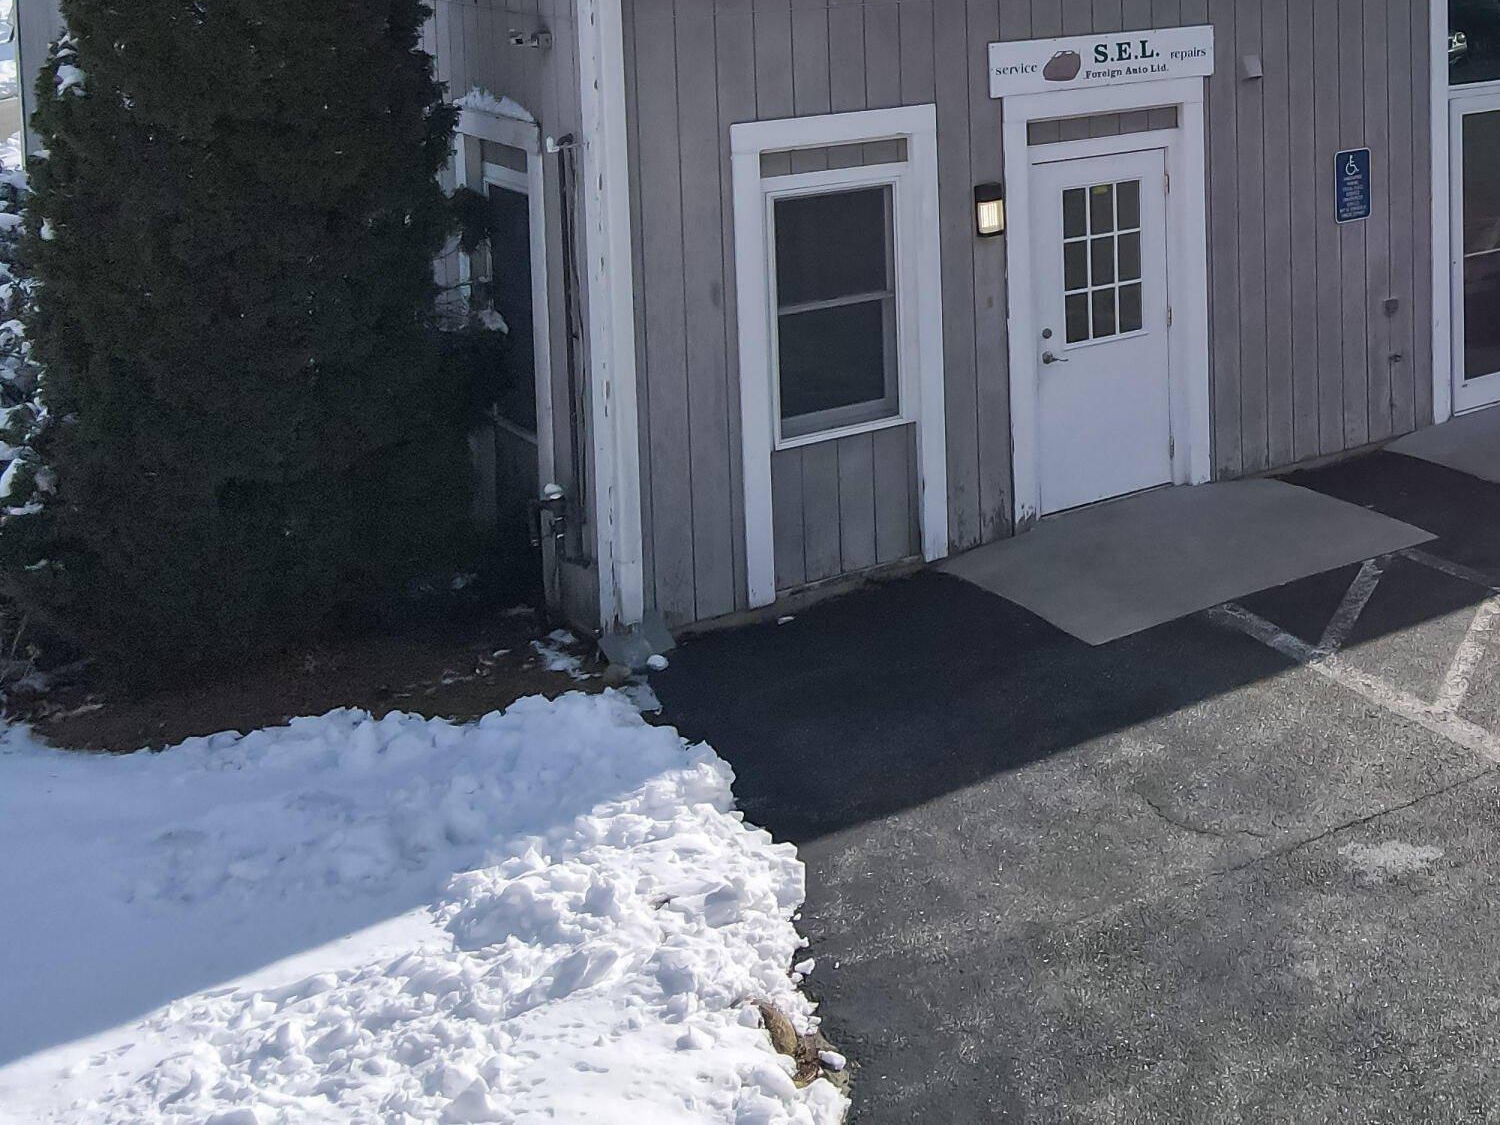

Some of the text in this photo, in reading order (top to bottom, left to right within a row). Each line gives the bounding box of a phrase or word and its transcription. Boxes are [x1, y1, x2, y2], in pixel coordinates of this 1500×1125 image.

[1094, 40, 1160, 64] S.E.L.
[1170, 47, 1207, 61] repairs
[995, 63, 1038, 76] service
[1085, 68, 1123, 80] Foreign
[1125, 65, 1149, 76] Auto
